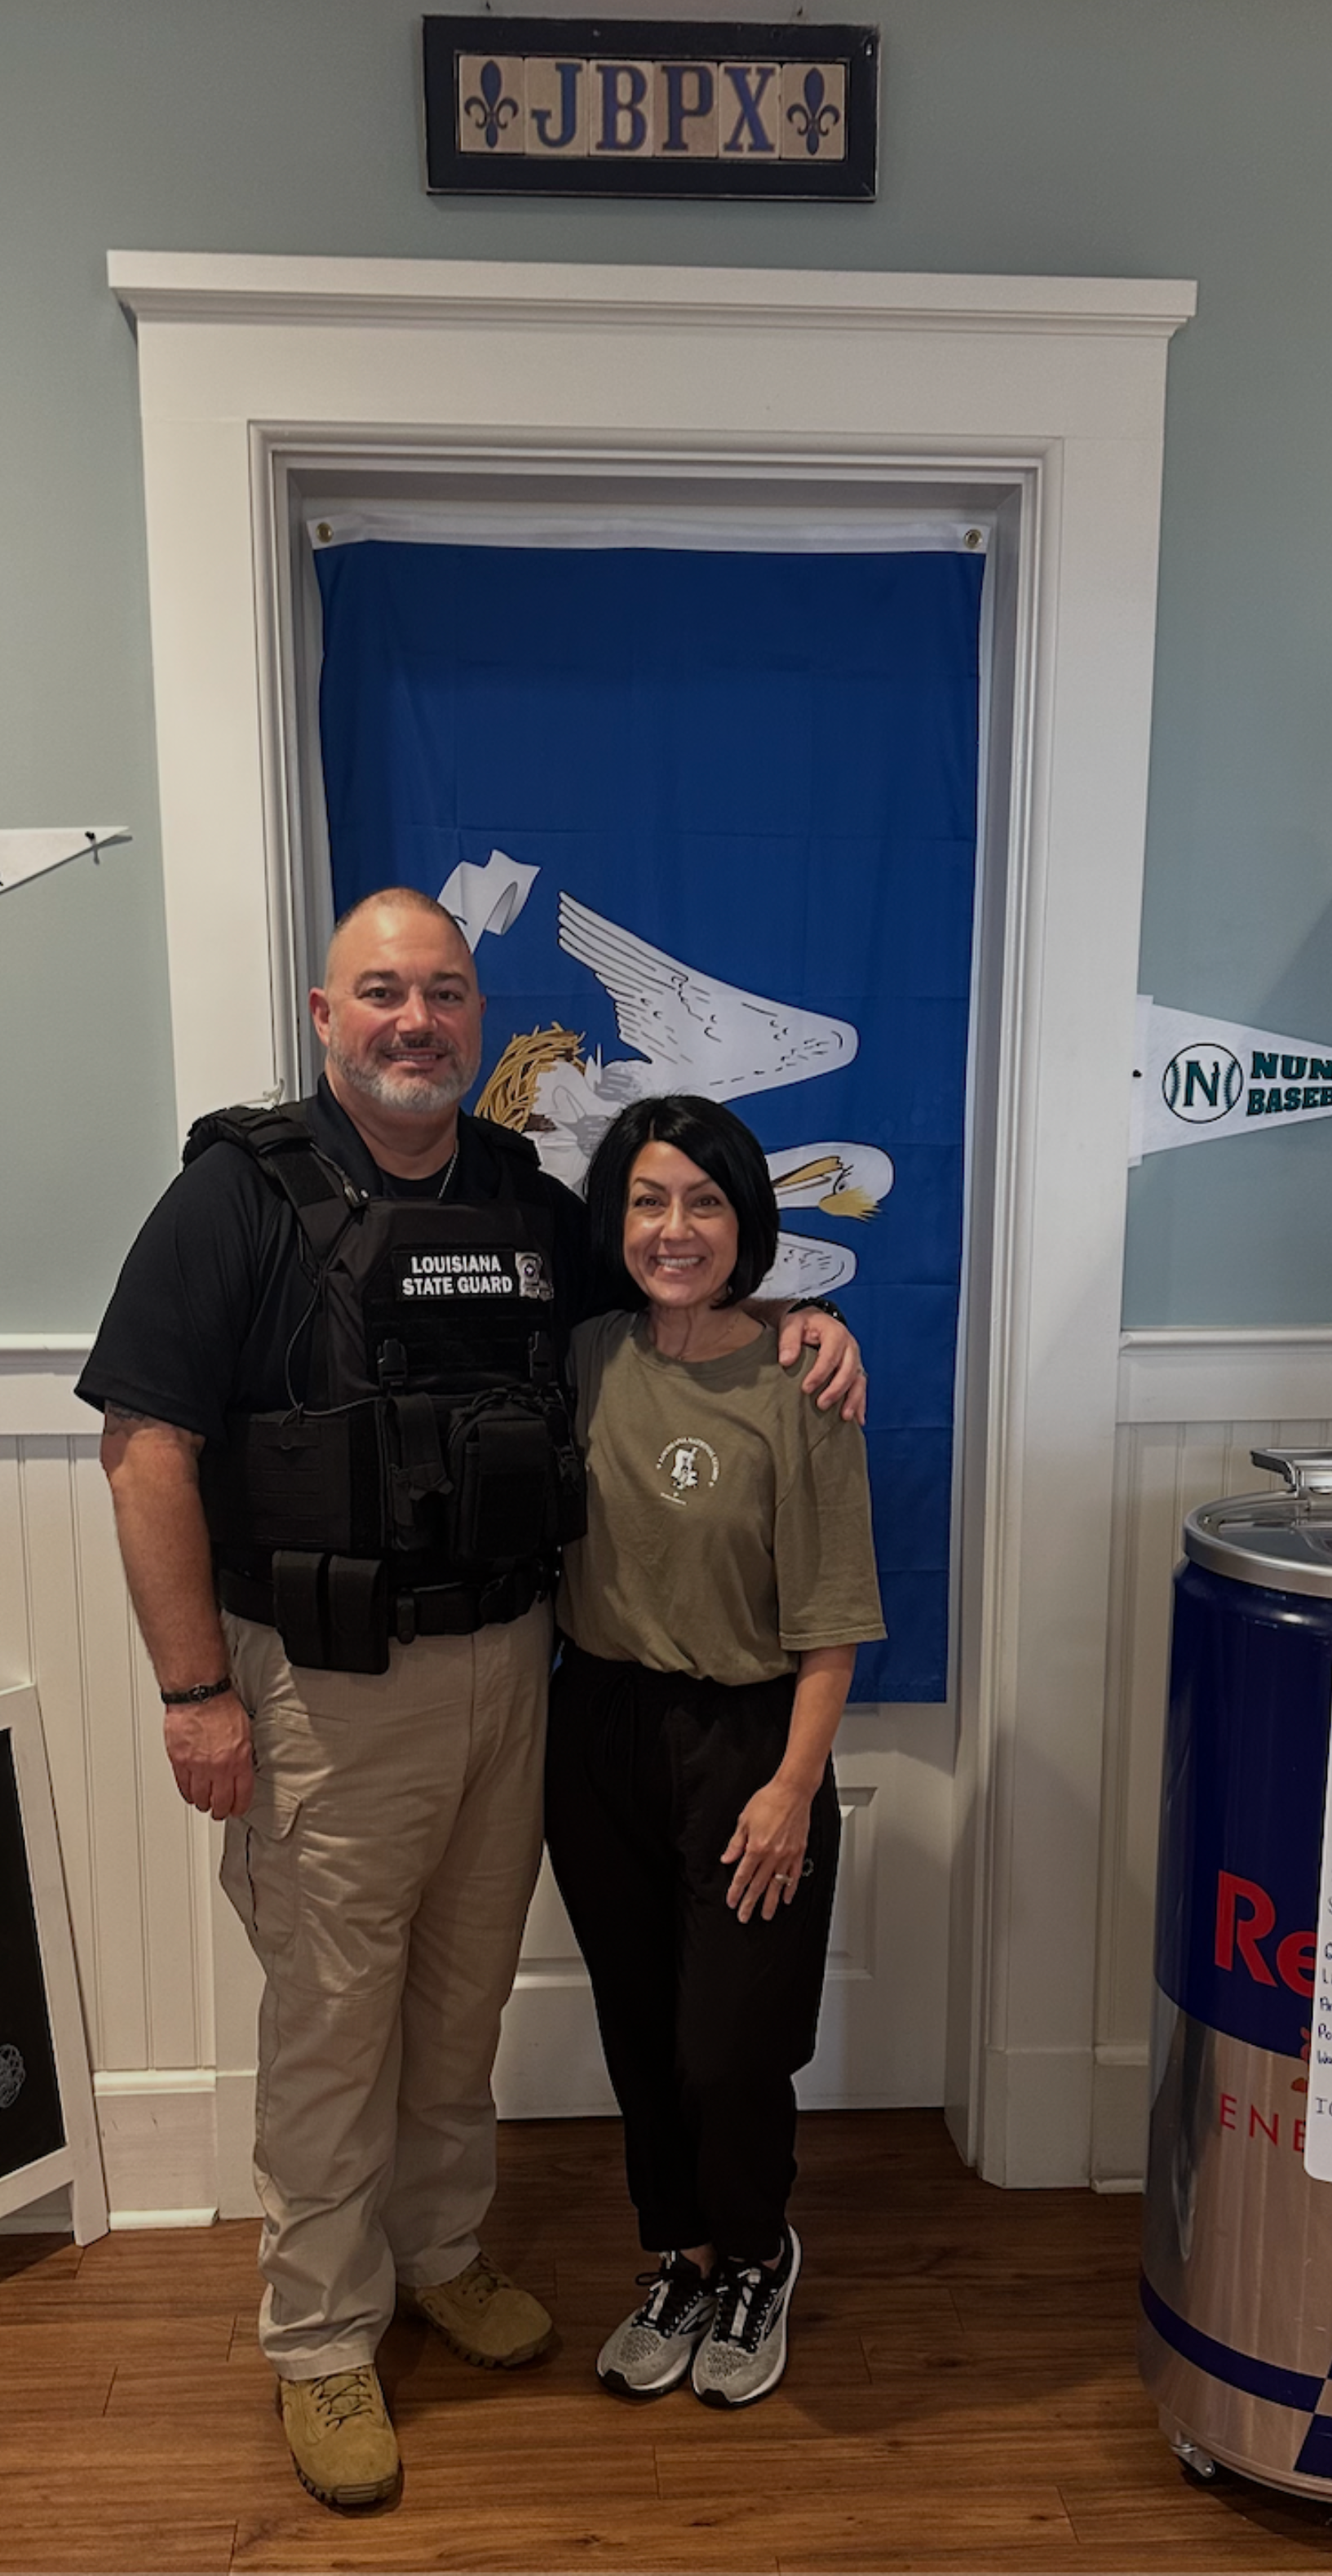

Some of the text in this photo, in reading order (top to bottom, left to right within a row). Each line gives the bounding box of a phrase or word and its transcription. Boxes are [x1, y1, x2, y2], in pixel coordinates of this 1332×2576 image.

[530, 62, 777, 153] JBPX
[1183, 1060, 1221, 1107] N
[411, 1255, 502, 1274] LOUISIANA
[402, 1275, 513, 1296] STATE GUARD
